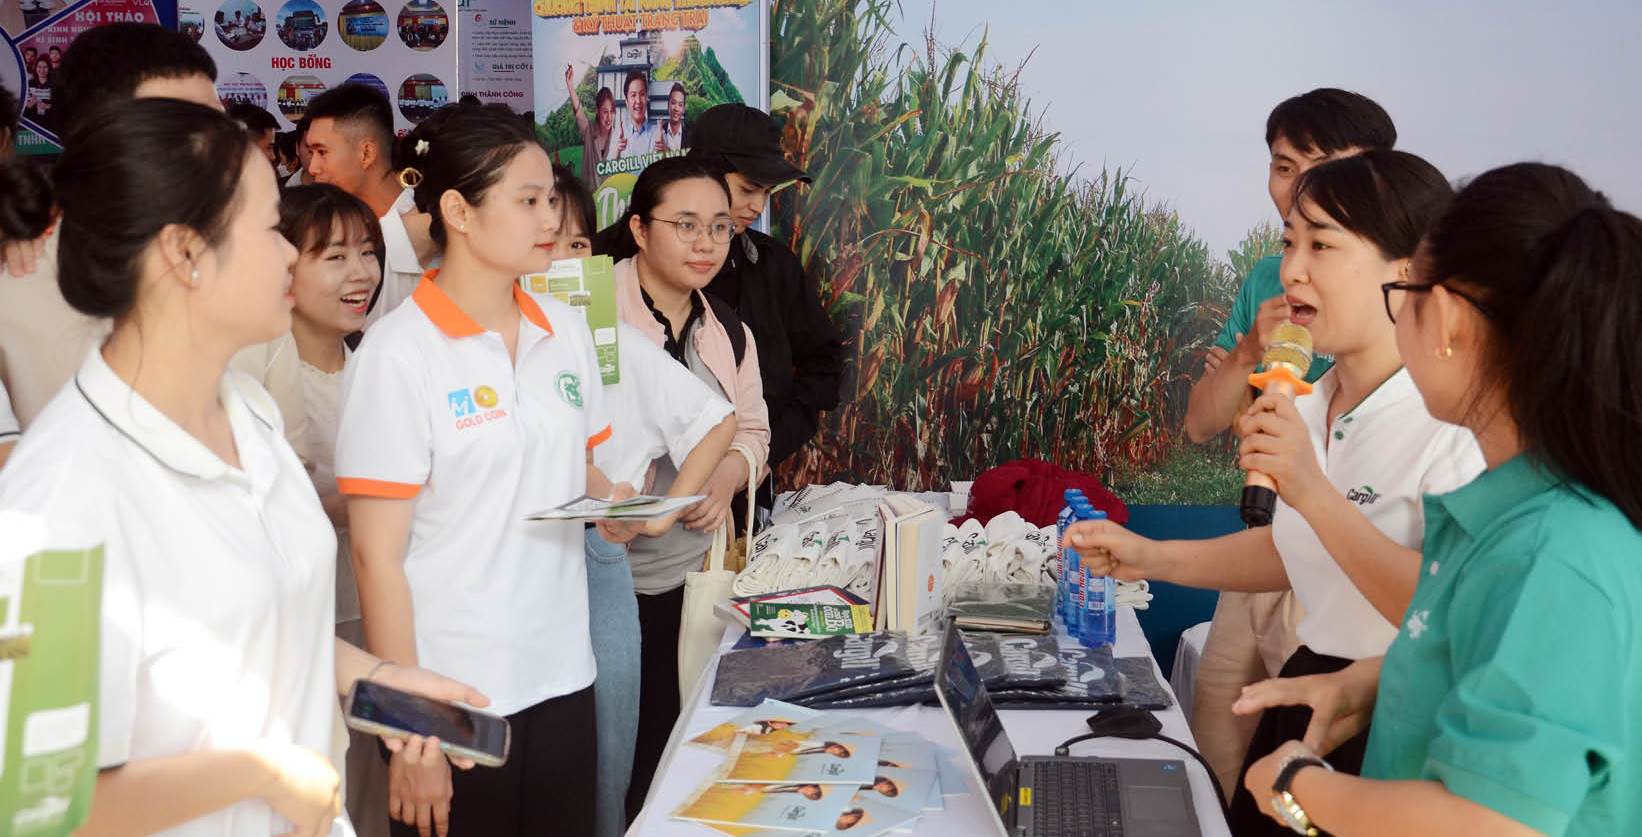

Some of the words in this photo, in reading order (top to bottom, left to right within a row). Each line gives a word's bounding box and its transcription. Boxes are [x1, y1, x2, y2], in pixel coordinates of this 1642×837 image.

[75, 11, 101, 24] HỘI
[105, 10, 144, 23] THẢO
[271, 57, 295, 71] HỌC
[502, 90, 524, 98] CÔNG
[596, 156, 641, 175] CARGILL
[455, 414, 484, 431] GOLD
[1346, 486, 1378, 505] Cargill
